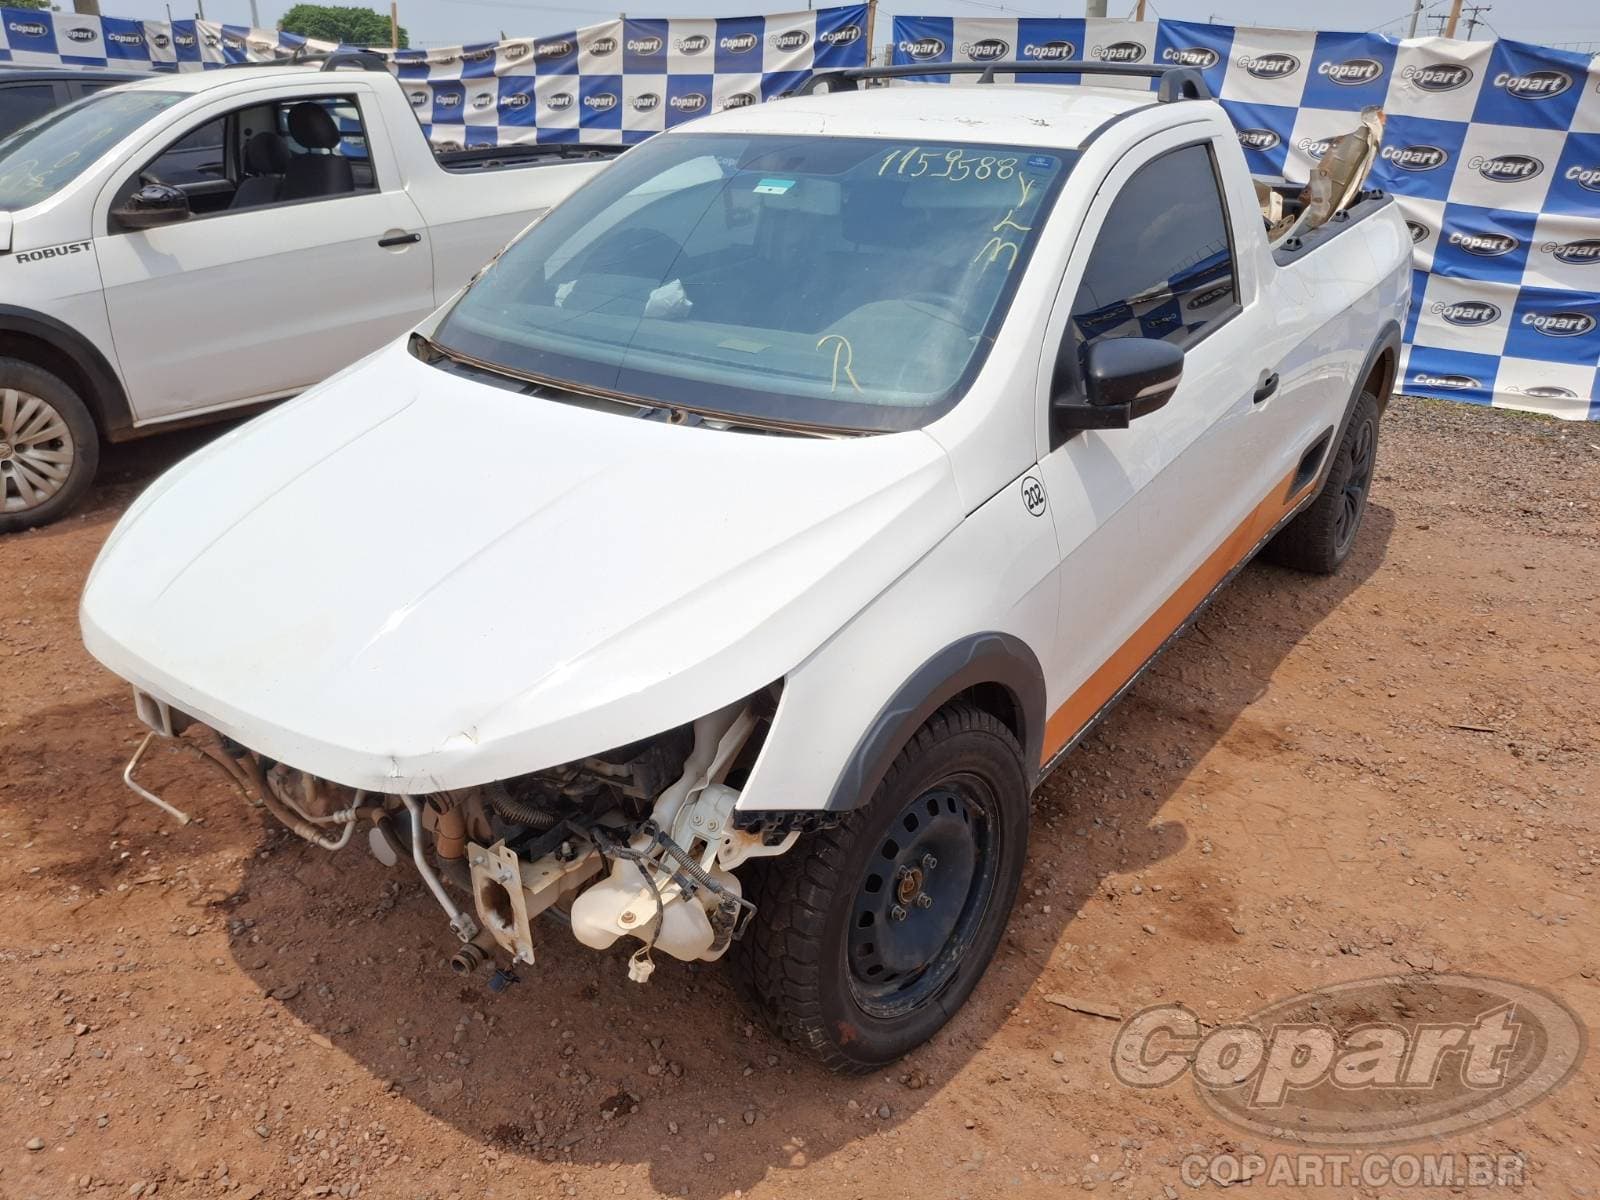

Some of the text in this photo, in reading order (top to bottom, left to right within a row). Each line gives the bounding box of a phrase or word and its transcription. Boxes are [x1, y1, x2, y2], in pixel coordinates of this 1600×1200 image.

[9, 22, 43, 34] Copart
[820, 28, 857, 43] Copart
[108, 33, 140, 43] Copart
[627, 39, 658, 51] Copart
[720, 37, 752, 49] Copart
[538, 44, 568, 55] Copart
[899, 41, 939, 54] Copart
[960, 42, 1002, 55] Copart
[1024, 44, 1068, 57] Copart
[1090, 44, 1138, 59] Copart
[1162, 48, 1212, 65] Copart
[1237, 55, 1292, 72] Copart
[1318, 61, 1375, 77] Copart
[1401, 65, 1464, 84] Copart
[1494, 73, 1562, 91] Copart
[584, 96, 613, 106] Copart
[670, 96, 702, 108] Copart
[1381, 145, 1439, 164] Copart
[1467, 155, 1534, 175] Copart
[1449, 231, 1512, 249] Copart
[15, 241, 92, 264] ROBUST
[1430, 301, 1493, 320] Copart
[1521, 312, 1588, 330] Copart
[815, 334, 864, 396] R
[1023, 483, 1044, 510] 202
